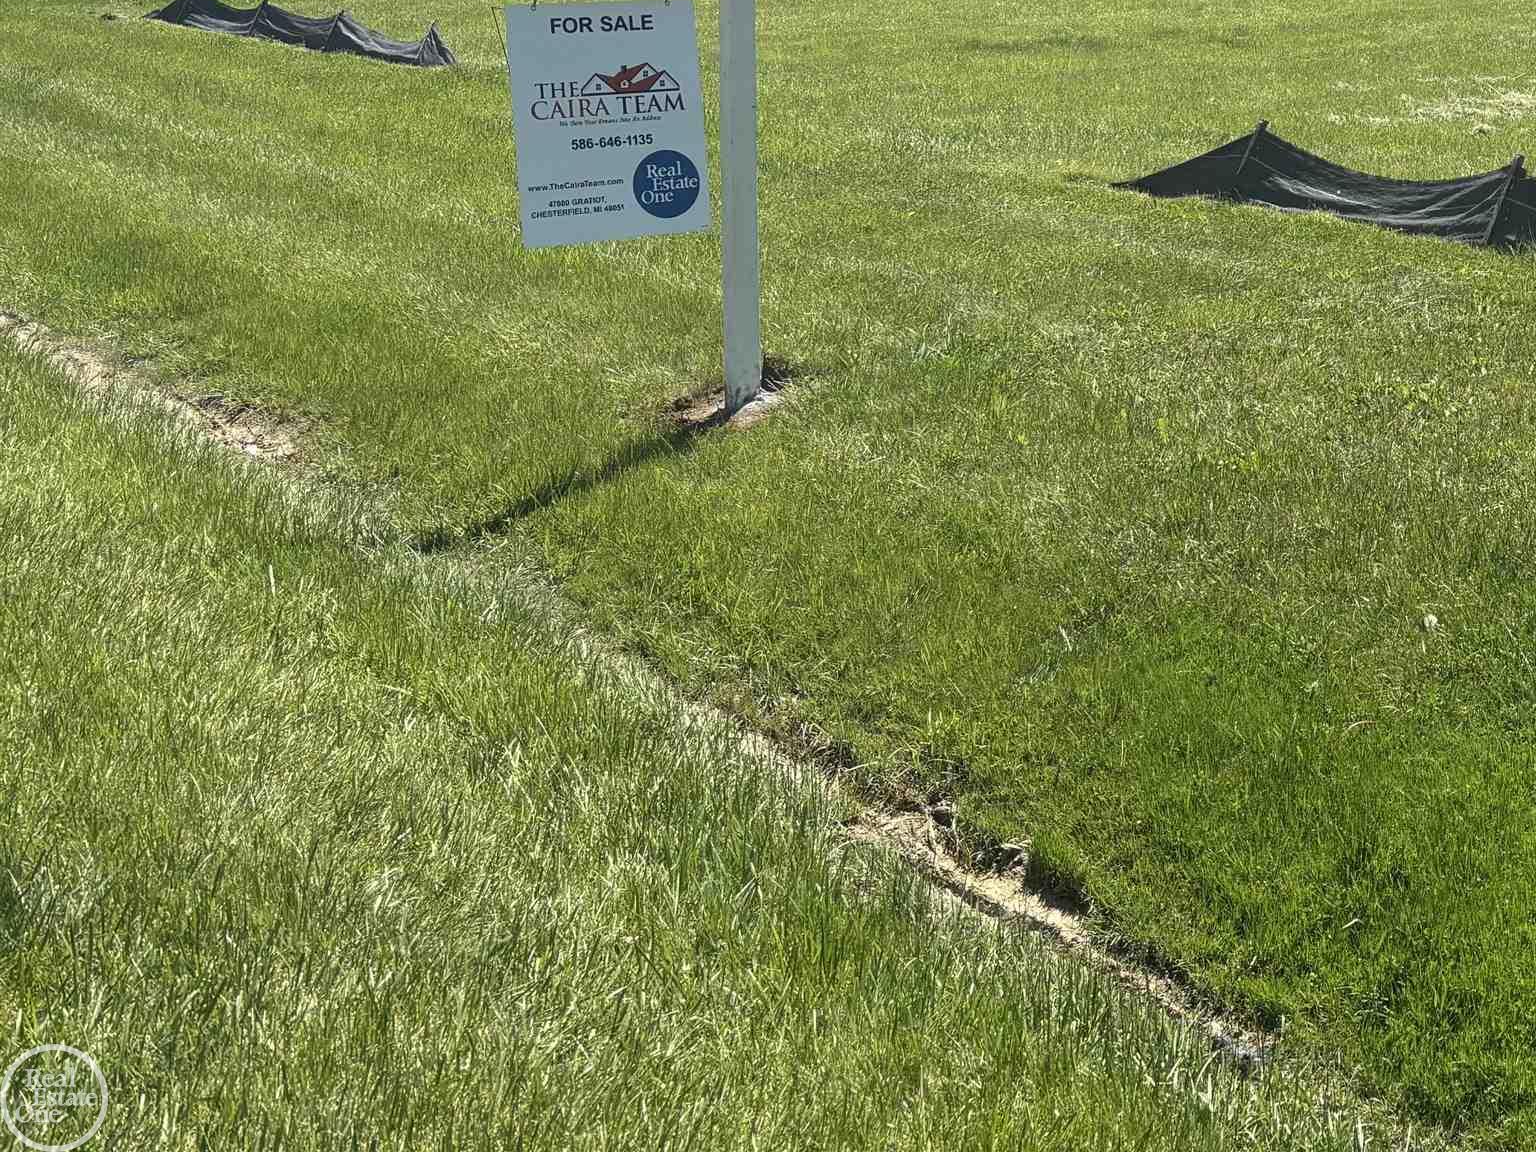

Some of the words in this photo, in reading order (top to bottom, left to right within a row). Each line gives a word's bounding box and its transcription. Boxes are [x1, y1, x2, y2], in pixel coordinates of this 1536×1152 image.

[550, 17, 593, 34] FOR
[600, 14, 654, 33] SALE
[534, 81, 579, 99] THE
[531, 97, 610, 121] CAIRA
[616, 92, 685, 115] TEAM
[571, 134, 654, 151] 586-646-1135
[647, 161, 682, 178] Real
[528, 179, 624, 192] www.TheCairaTeam.com
[652, 176, 699, 191] Estate
[640, 191, 674, 205] One
